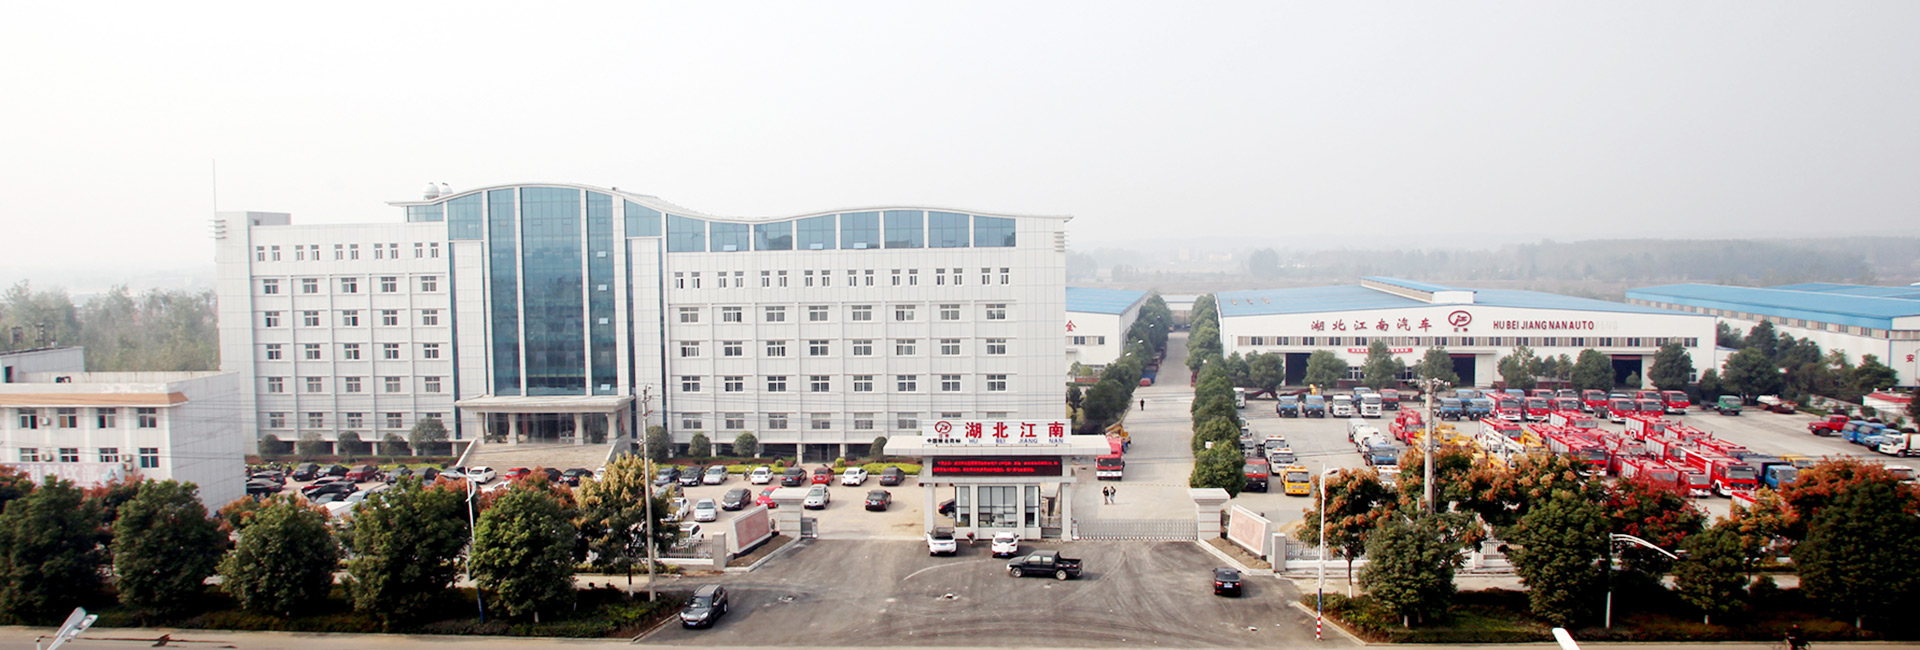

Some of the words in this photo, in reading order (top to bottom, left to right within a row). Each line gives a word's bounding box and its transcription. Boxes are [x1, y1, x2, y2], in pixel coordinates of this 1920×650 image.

[1310, 317, 1432, 332] 湖北江南汽车
[1521, 320, 1547, 330] JIANG
[965, 422, 1065, 438] 湖北江南
